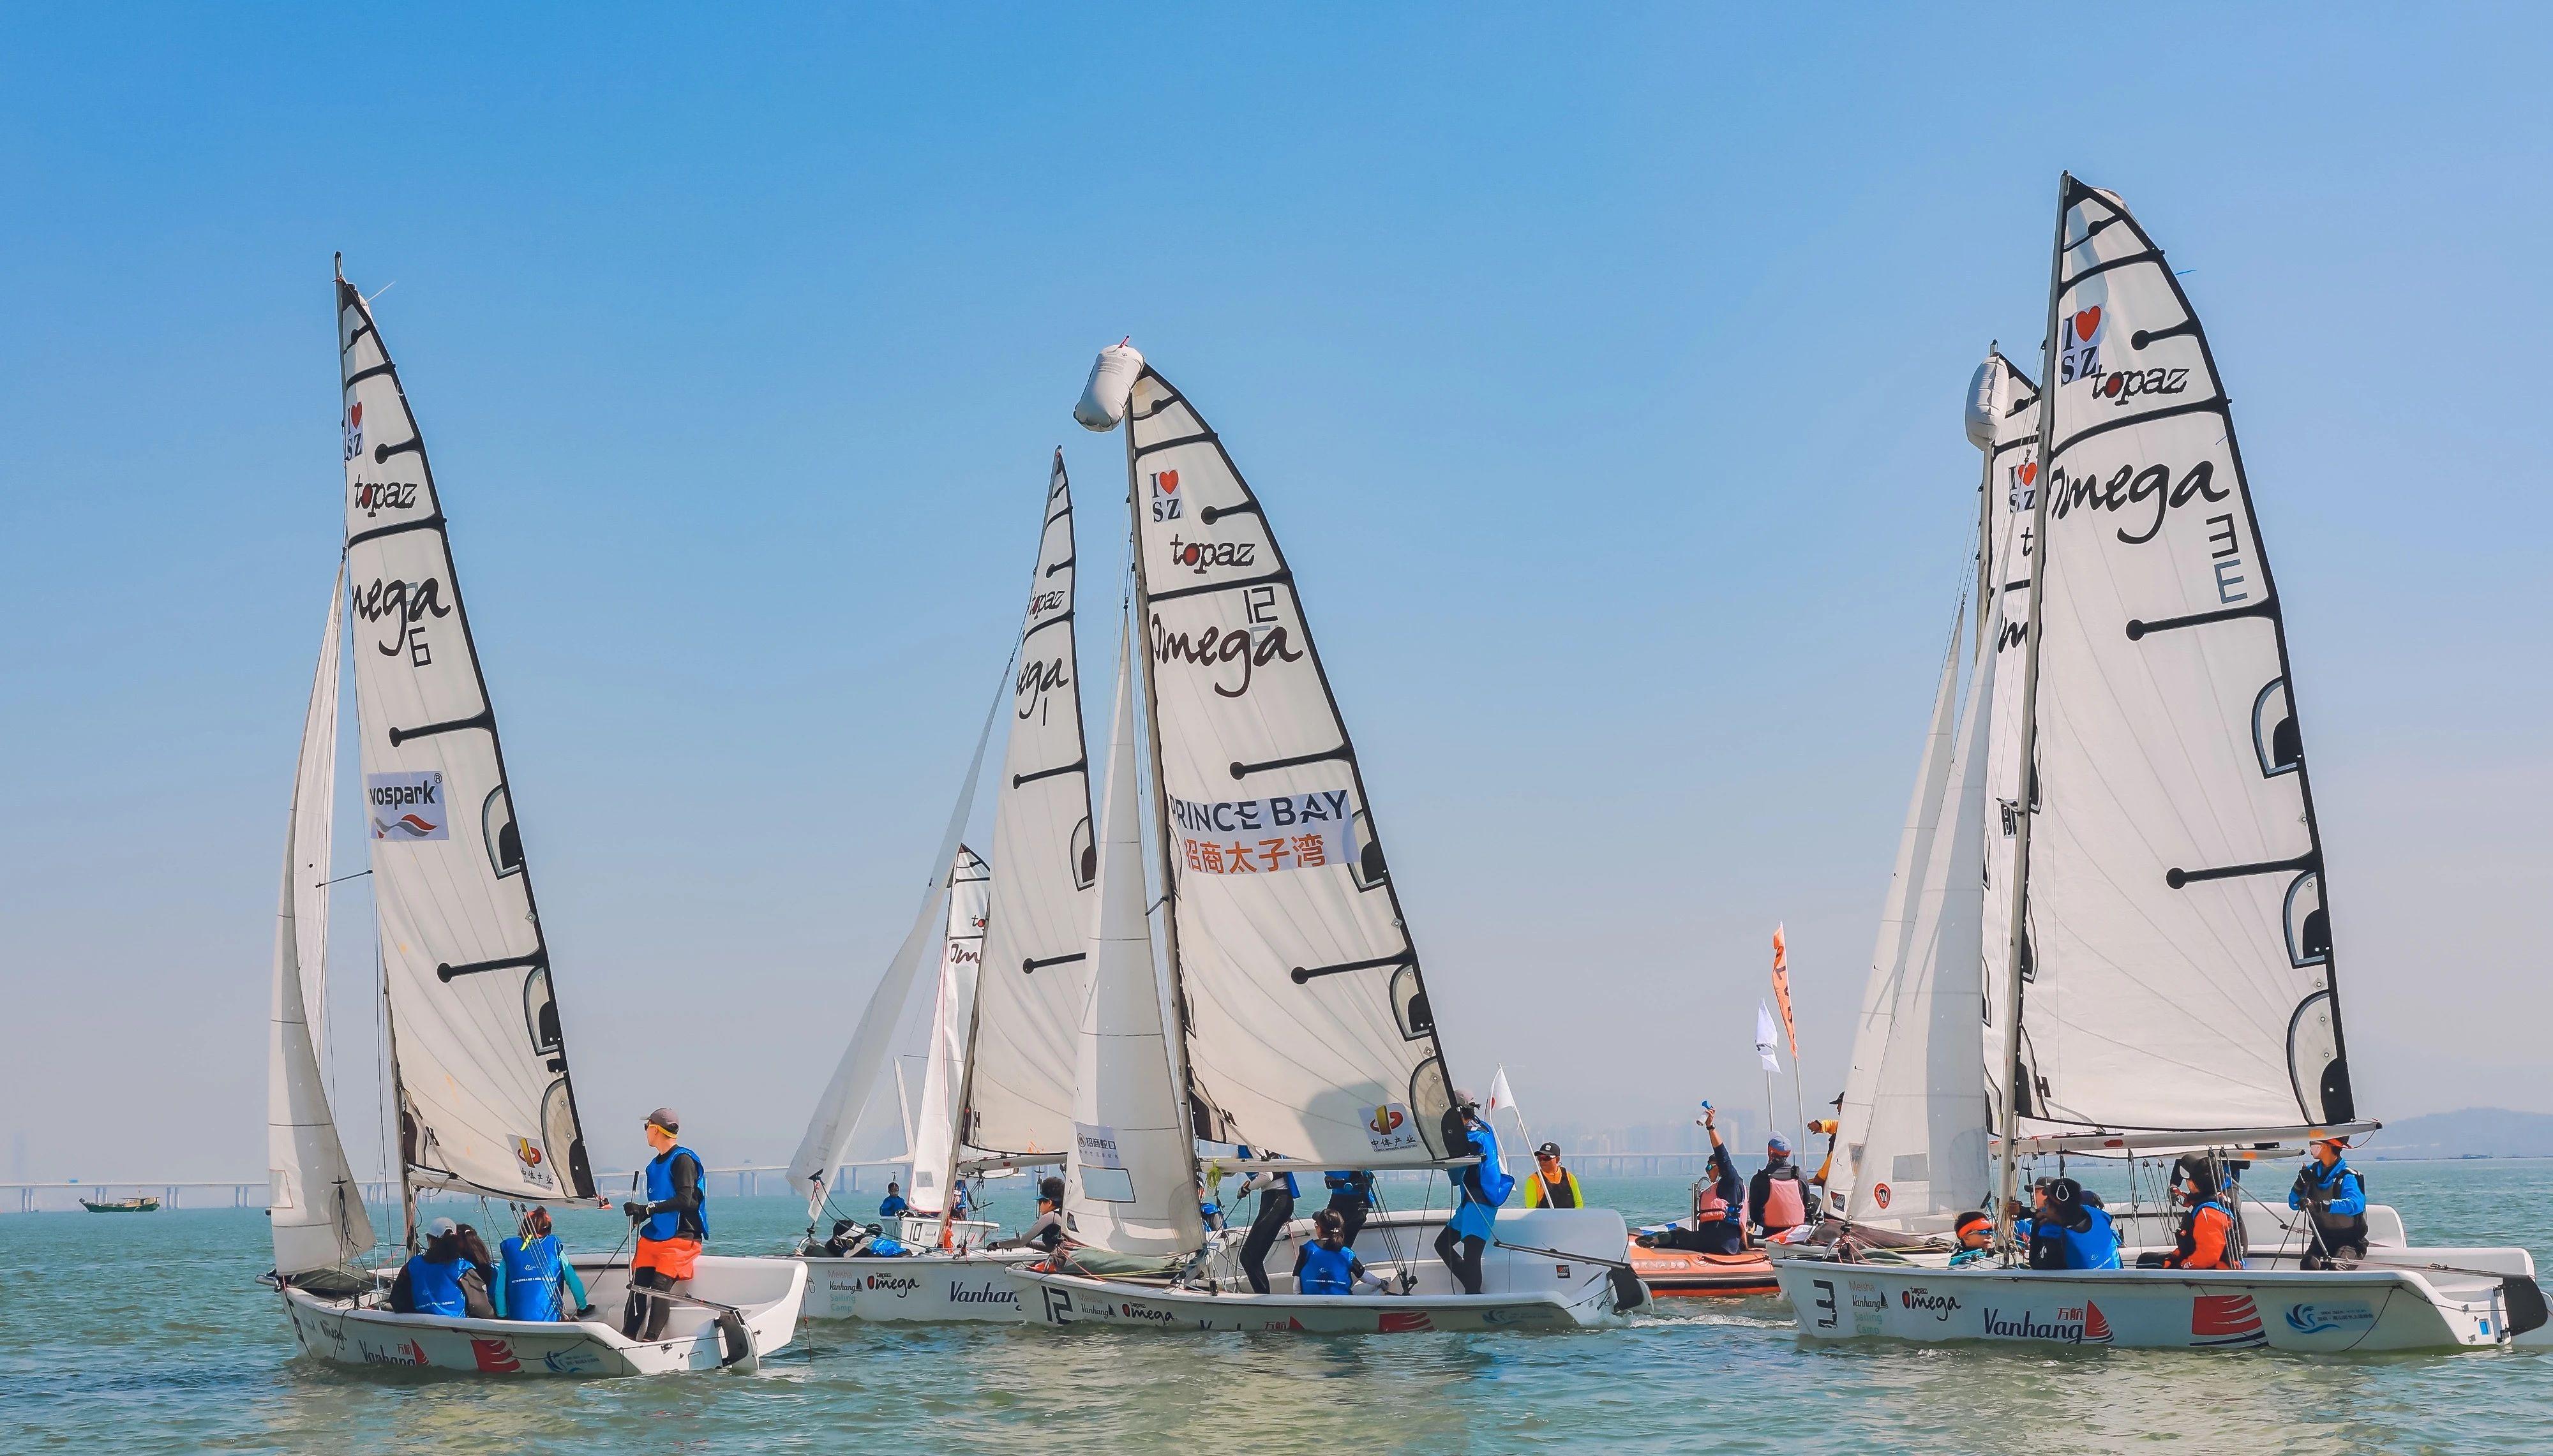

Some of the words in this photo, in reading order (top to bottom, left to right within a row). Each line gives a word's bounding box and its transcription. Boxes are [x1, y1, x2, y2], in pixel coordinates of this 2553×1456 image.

[2063, 316, 2074, 351] I
[2091, 364, 2190, 406] topaz
[354, 473, 417, 517] topaz
[1150, 473, 1160, 498] I
[2206, 513, 2238, 559] 3
[1170, 533, 1255, 574] topaz
[1243, 586, 1278, 623] 12
[408, 627, 431, 667] 6
[1169, 794, 1262, 832] PRINCE
[1269, 789, 1347, 826] BAY
[1184, 833, 1326, 874] 招商太子湾
[1371, 1134, 1416, 1149] 中体产业
[910, 1223, 923, 1242] 10
[828, 1270, 852, 1279] Meisha
[867, 1275, 920, 1298] Omega
[1849, 1281, 1875, 1291] Meisha
[830, 1281, 855, 1294] Vanhang
[830, 1294, 856, 1304] Sailing
[950, 1281, 1021, 1311] Vanhan
[830, 1304, 852, 1313] Camp
[1041, 1285, 1074, 1325] 12
[1082, 1304, 1109, 1319] Vanhang
[1853, 1295, 1880, 1312] Vanhang
[1902, 1290, 1961, 1321] Omega
[2057, 1307, 2083, 1321] 万航
[1854, 1312, 1882, 1325] Sailing
[1857, 1324, 1880, 1335] Camp
[1984, 1307, 2084, 1344] Vanhang
